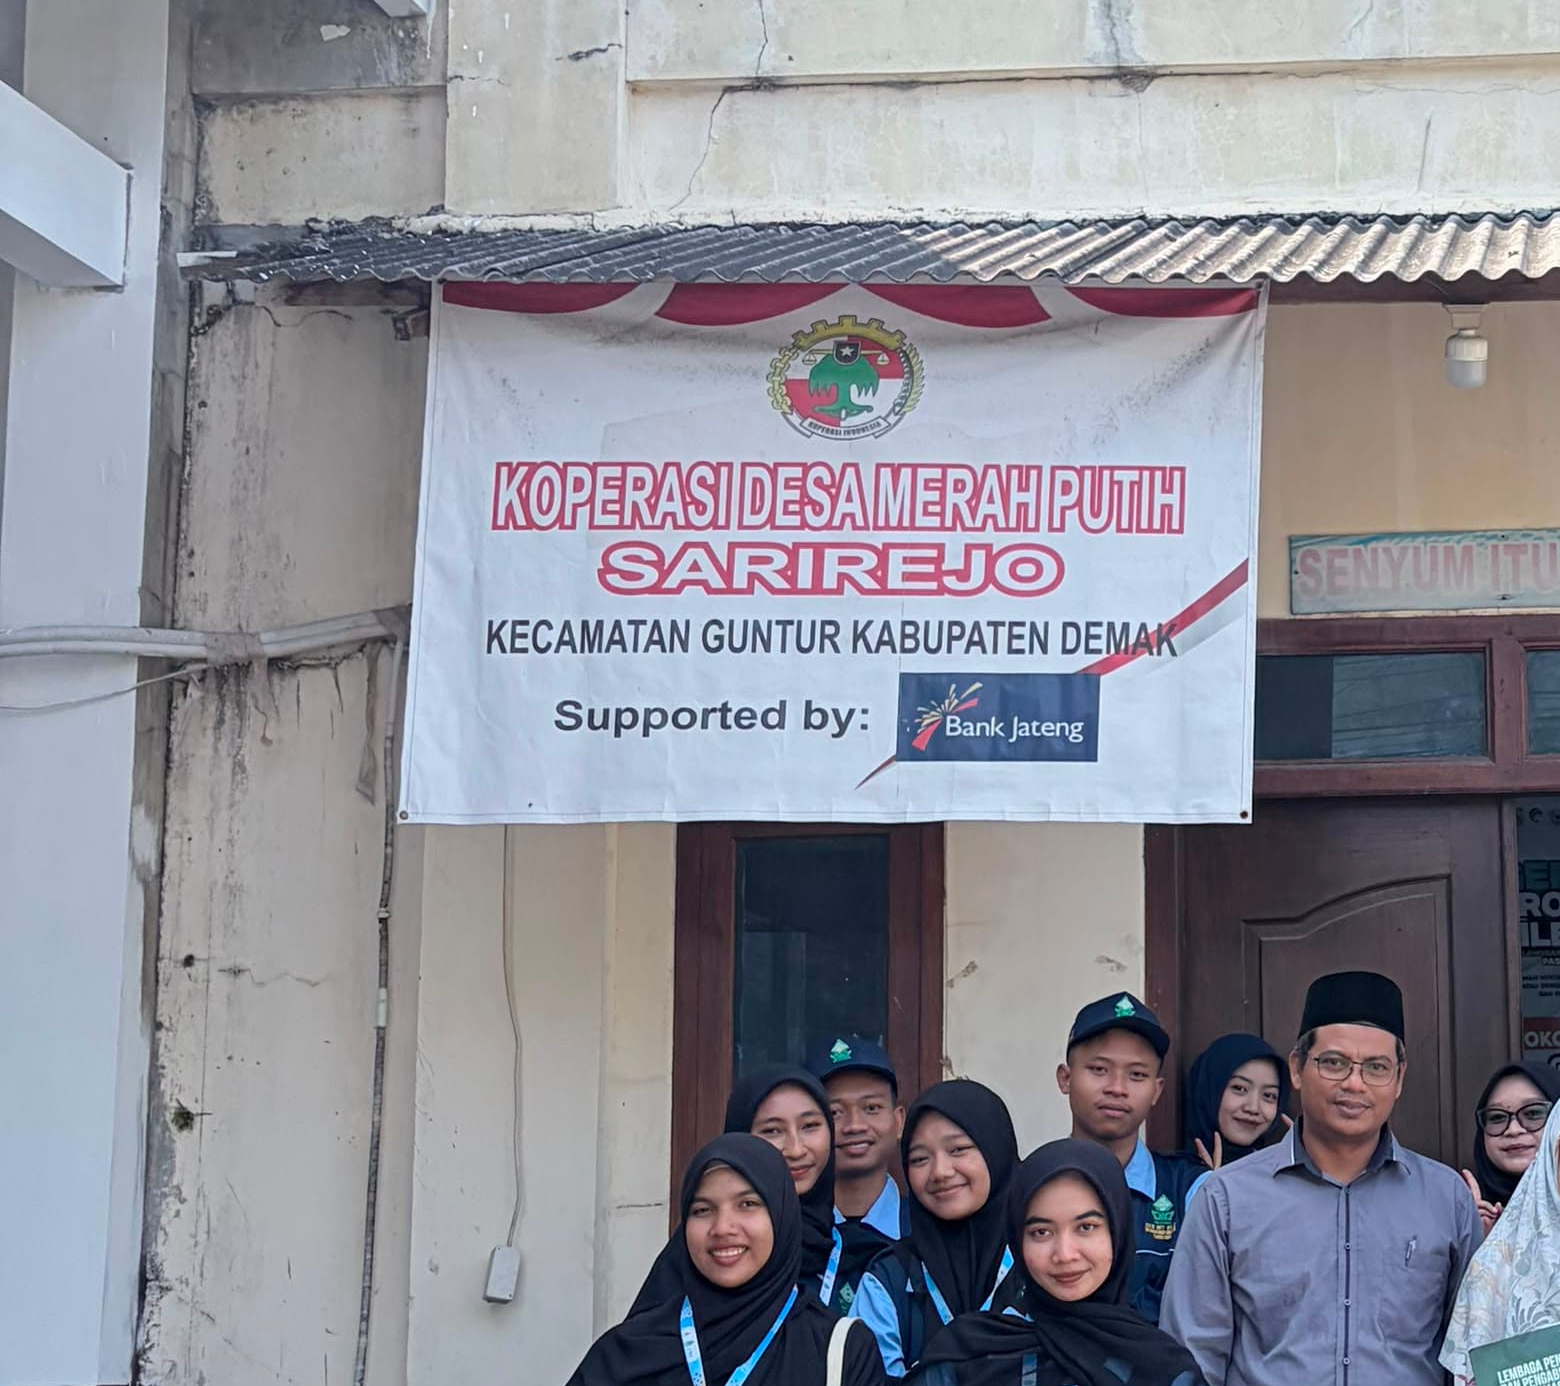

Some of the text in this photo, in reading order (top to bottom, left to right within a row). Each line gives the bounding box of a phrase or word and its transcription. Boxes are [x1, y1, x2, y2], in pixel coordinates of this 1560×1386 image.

[492, 462, 1186, 534] KOPERASI DESA MERAH PUTIH
[597, 541, 1065, 597] SARIREJO
[1299, 544, 1475, 598] SENYUM
[1490, 541, 1558, 592] ITU
[486, 619, 1178, 657] KECAMATAN GUNTUR KABUPATEN DEMAK
[554, 700, 870, 739] Supported by:
[945, 714, 1085, 744] Bank Jateng
[1497, 1359, 1544, 1384] LEMBAGA
